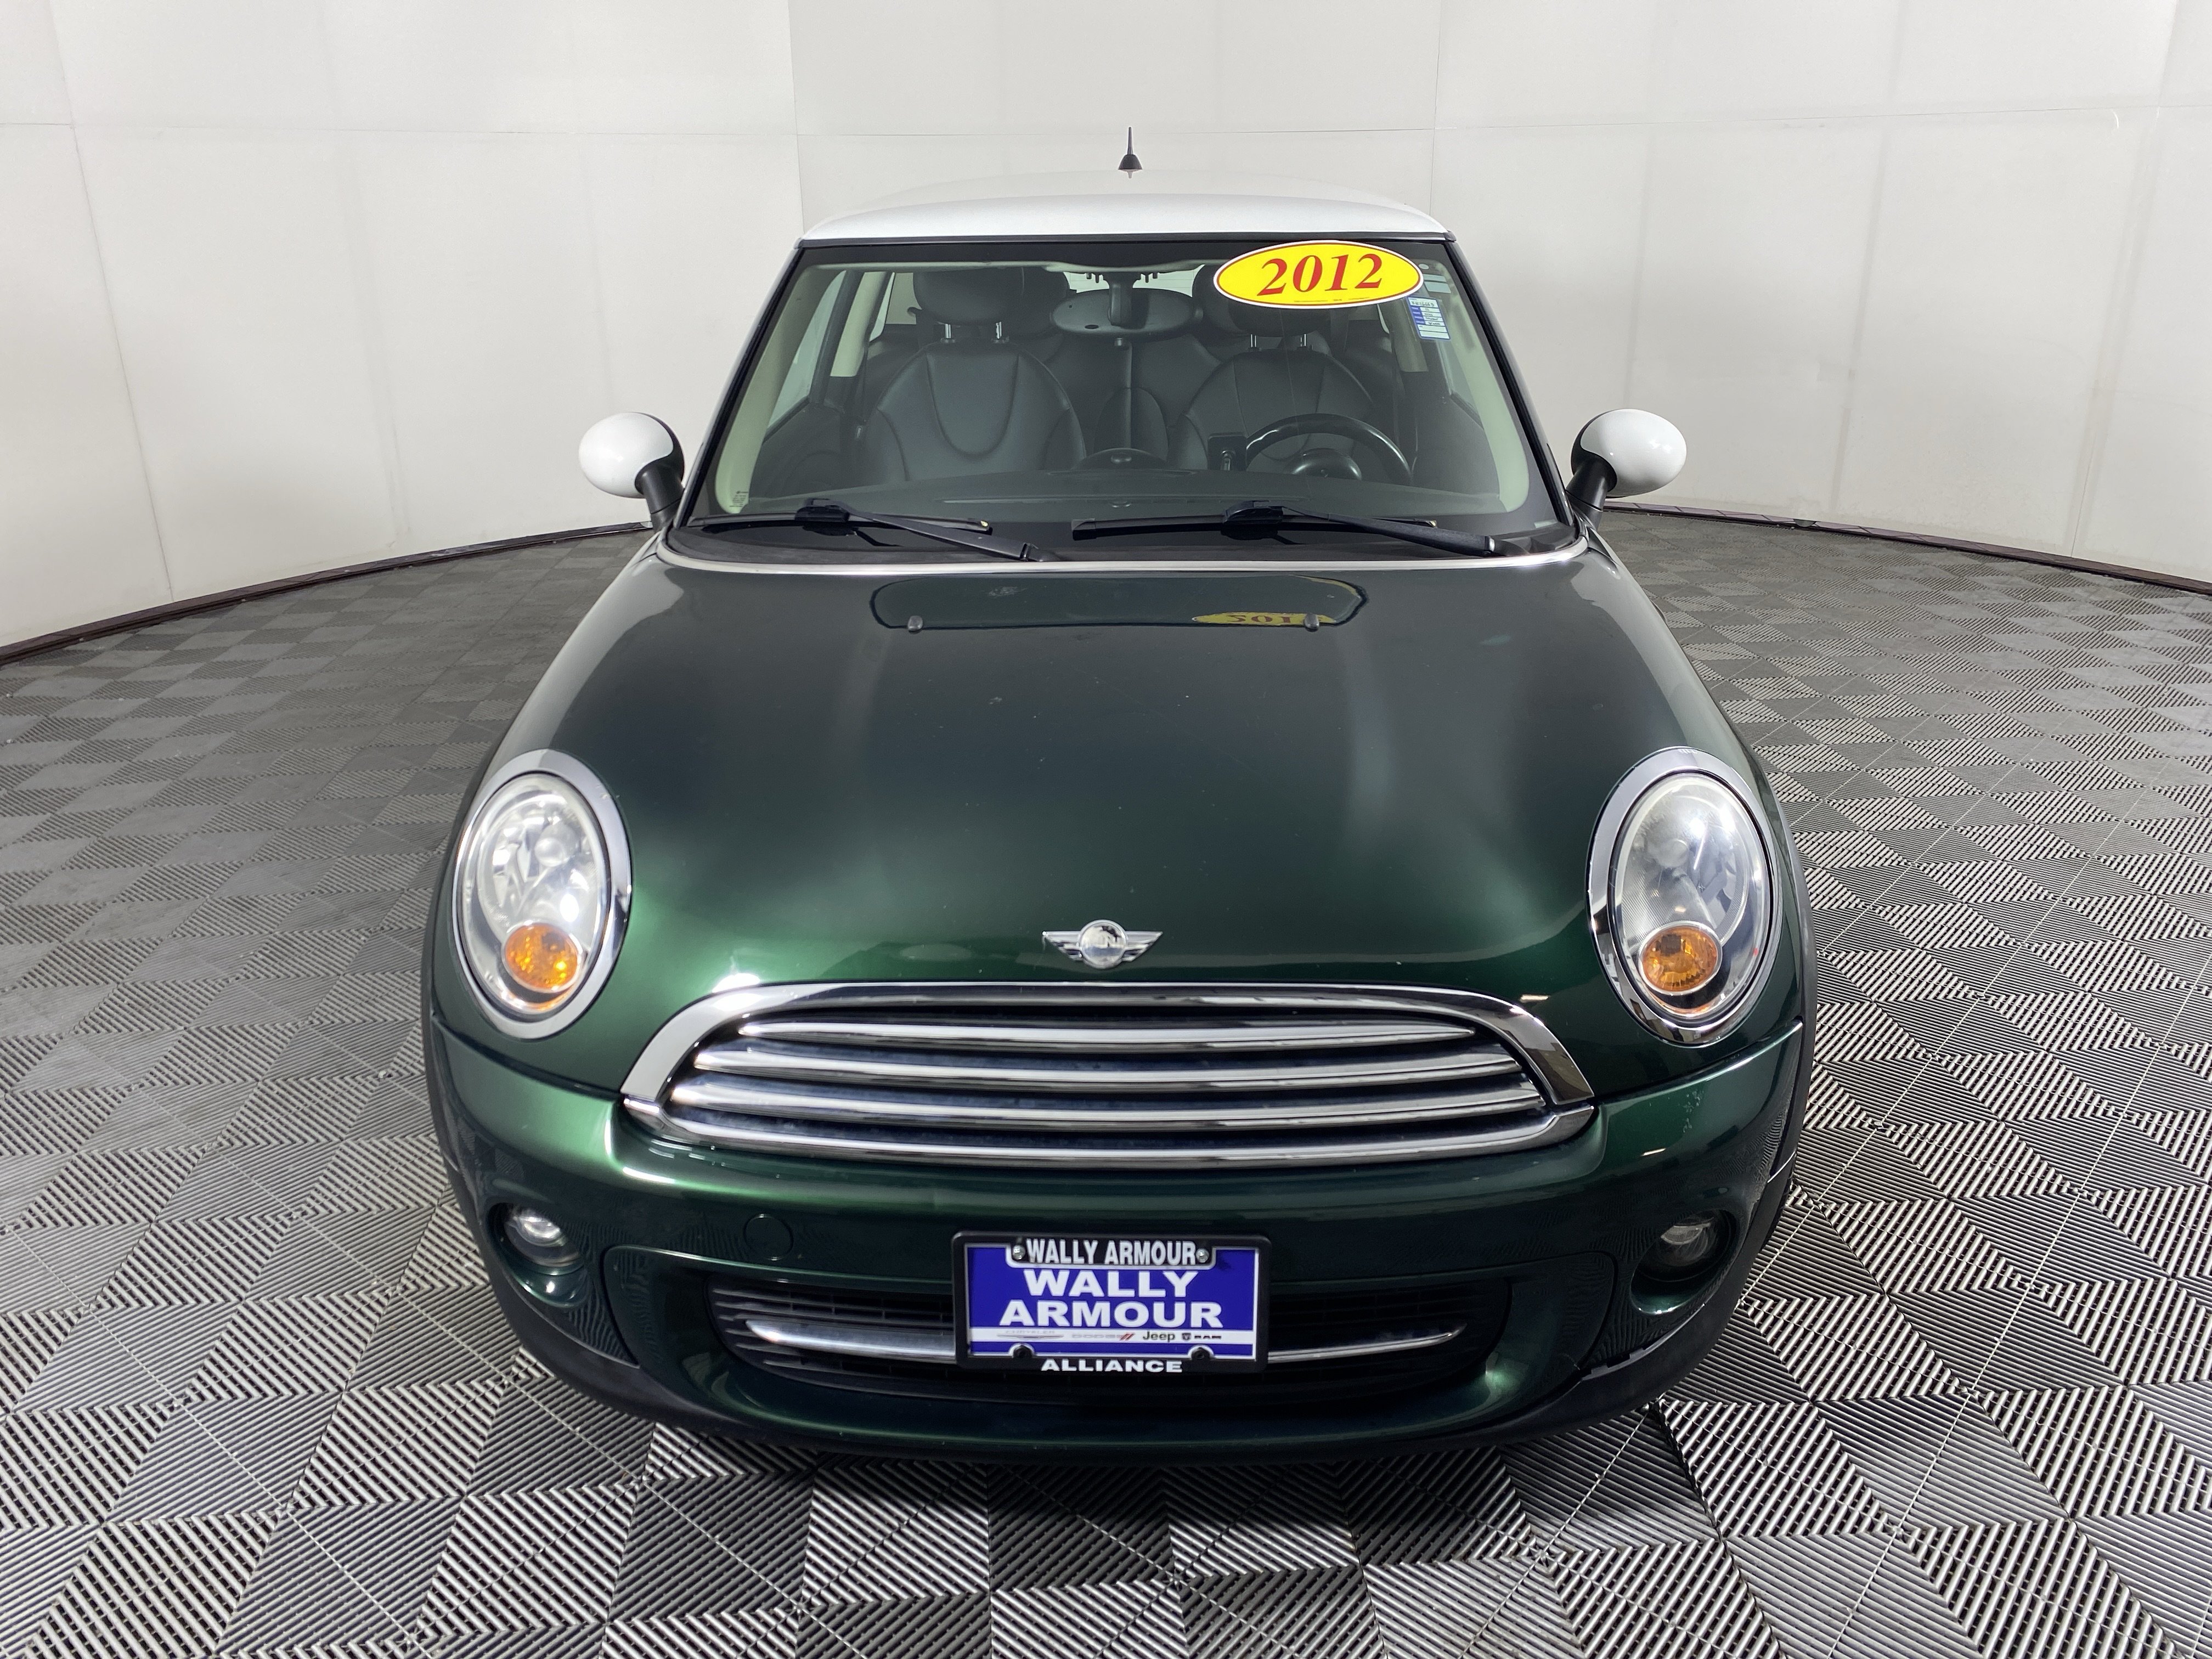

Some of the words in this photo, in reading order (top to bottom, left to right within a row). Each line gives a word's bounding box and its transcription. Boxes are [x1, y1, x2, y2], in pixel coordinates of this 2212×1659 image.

[1256, 253, 1383, 296] 2012
[1026, 1238, 1098, 1264] WALLY
[1104, 1240, 1196, 1266] ARMOUR
[1023, 1269, 1199, 1297] WALLY
[999, 1300, 1224, 1328] ARMOUR
[1142, 1331, 1176, 1342] Jeep
[1041, 1359, 1183, 1373] ALLIANCE
